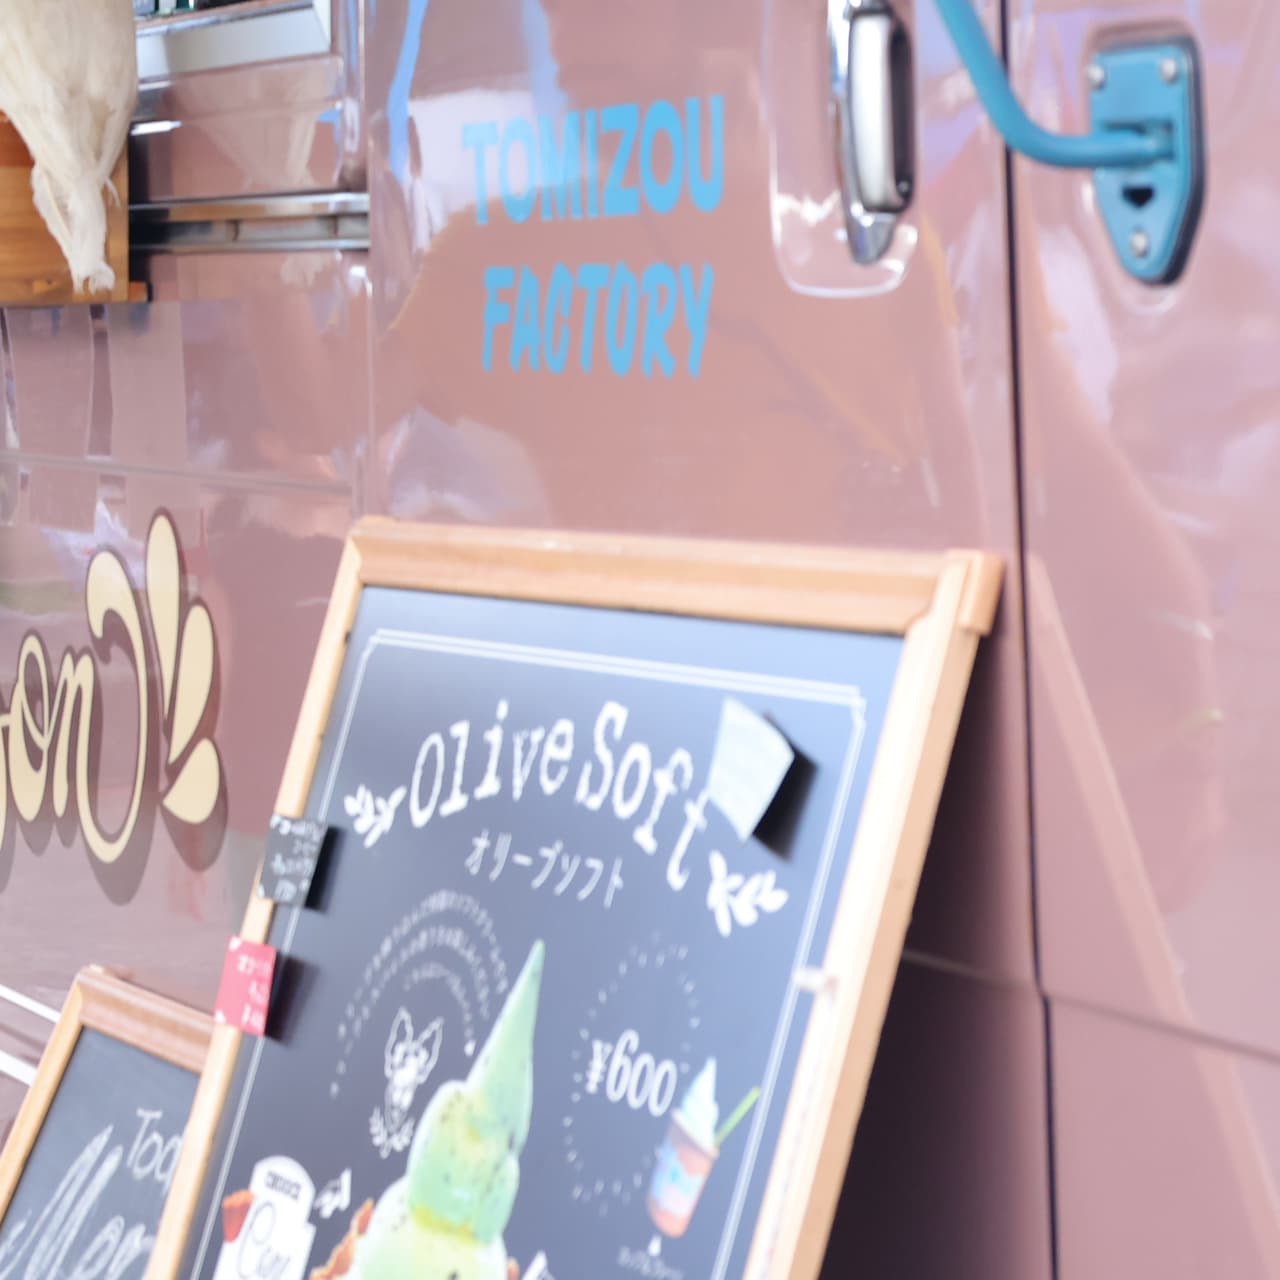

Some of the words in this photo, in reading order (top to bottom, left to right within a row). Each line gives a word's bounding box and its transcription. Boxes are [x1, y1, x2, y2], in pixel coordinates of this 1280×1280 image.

[461, 94, 725, 225] TOMIZOU
[481, 261, 714, 379] FACTORY
[575, 700, 713, 892] Soft
[464, 829, 624, 909] オリーブソフト
[585, 1028, 679, 1118] ¥600
